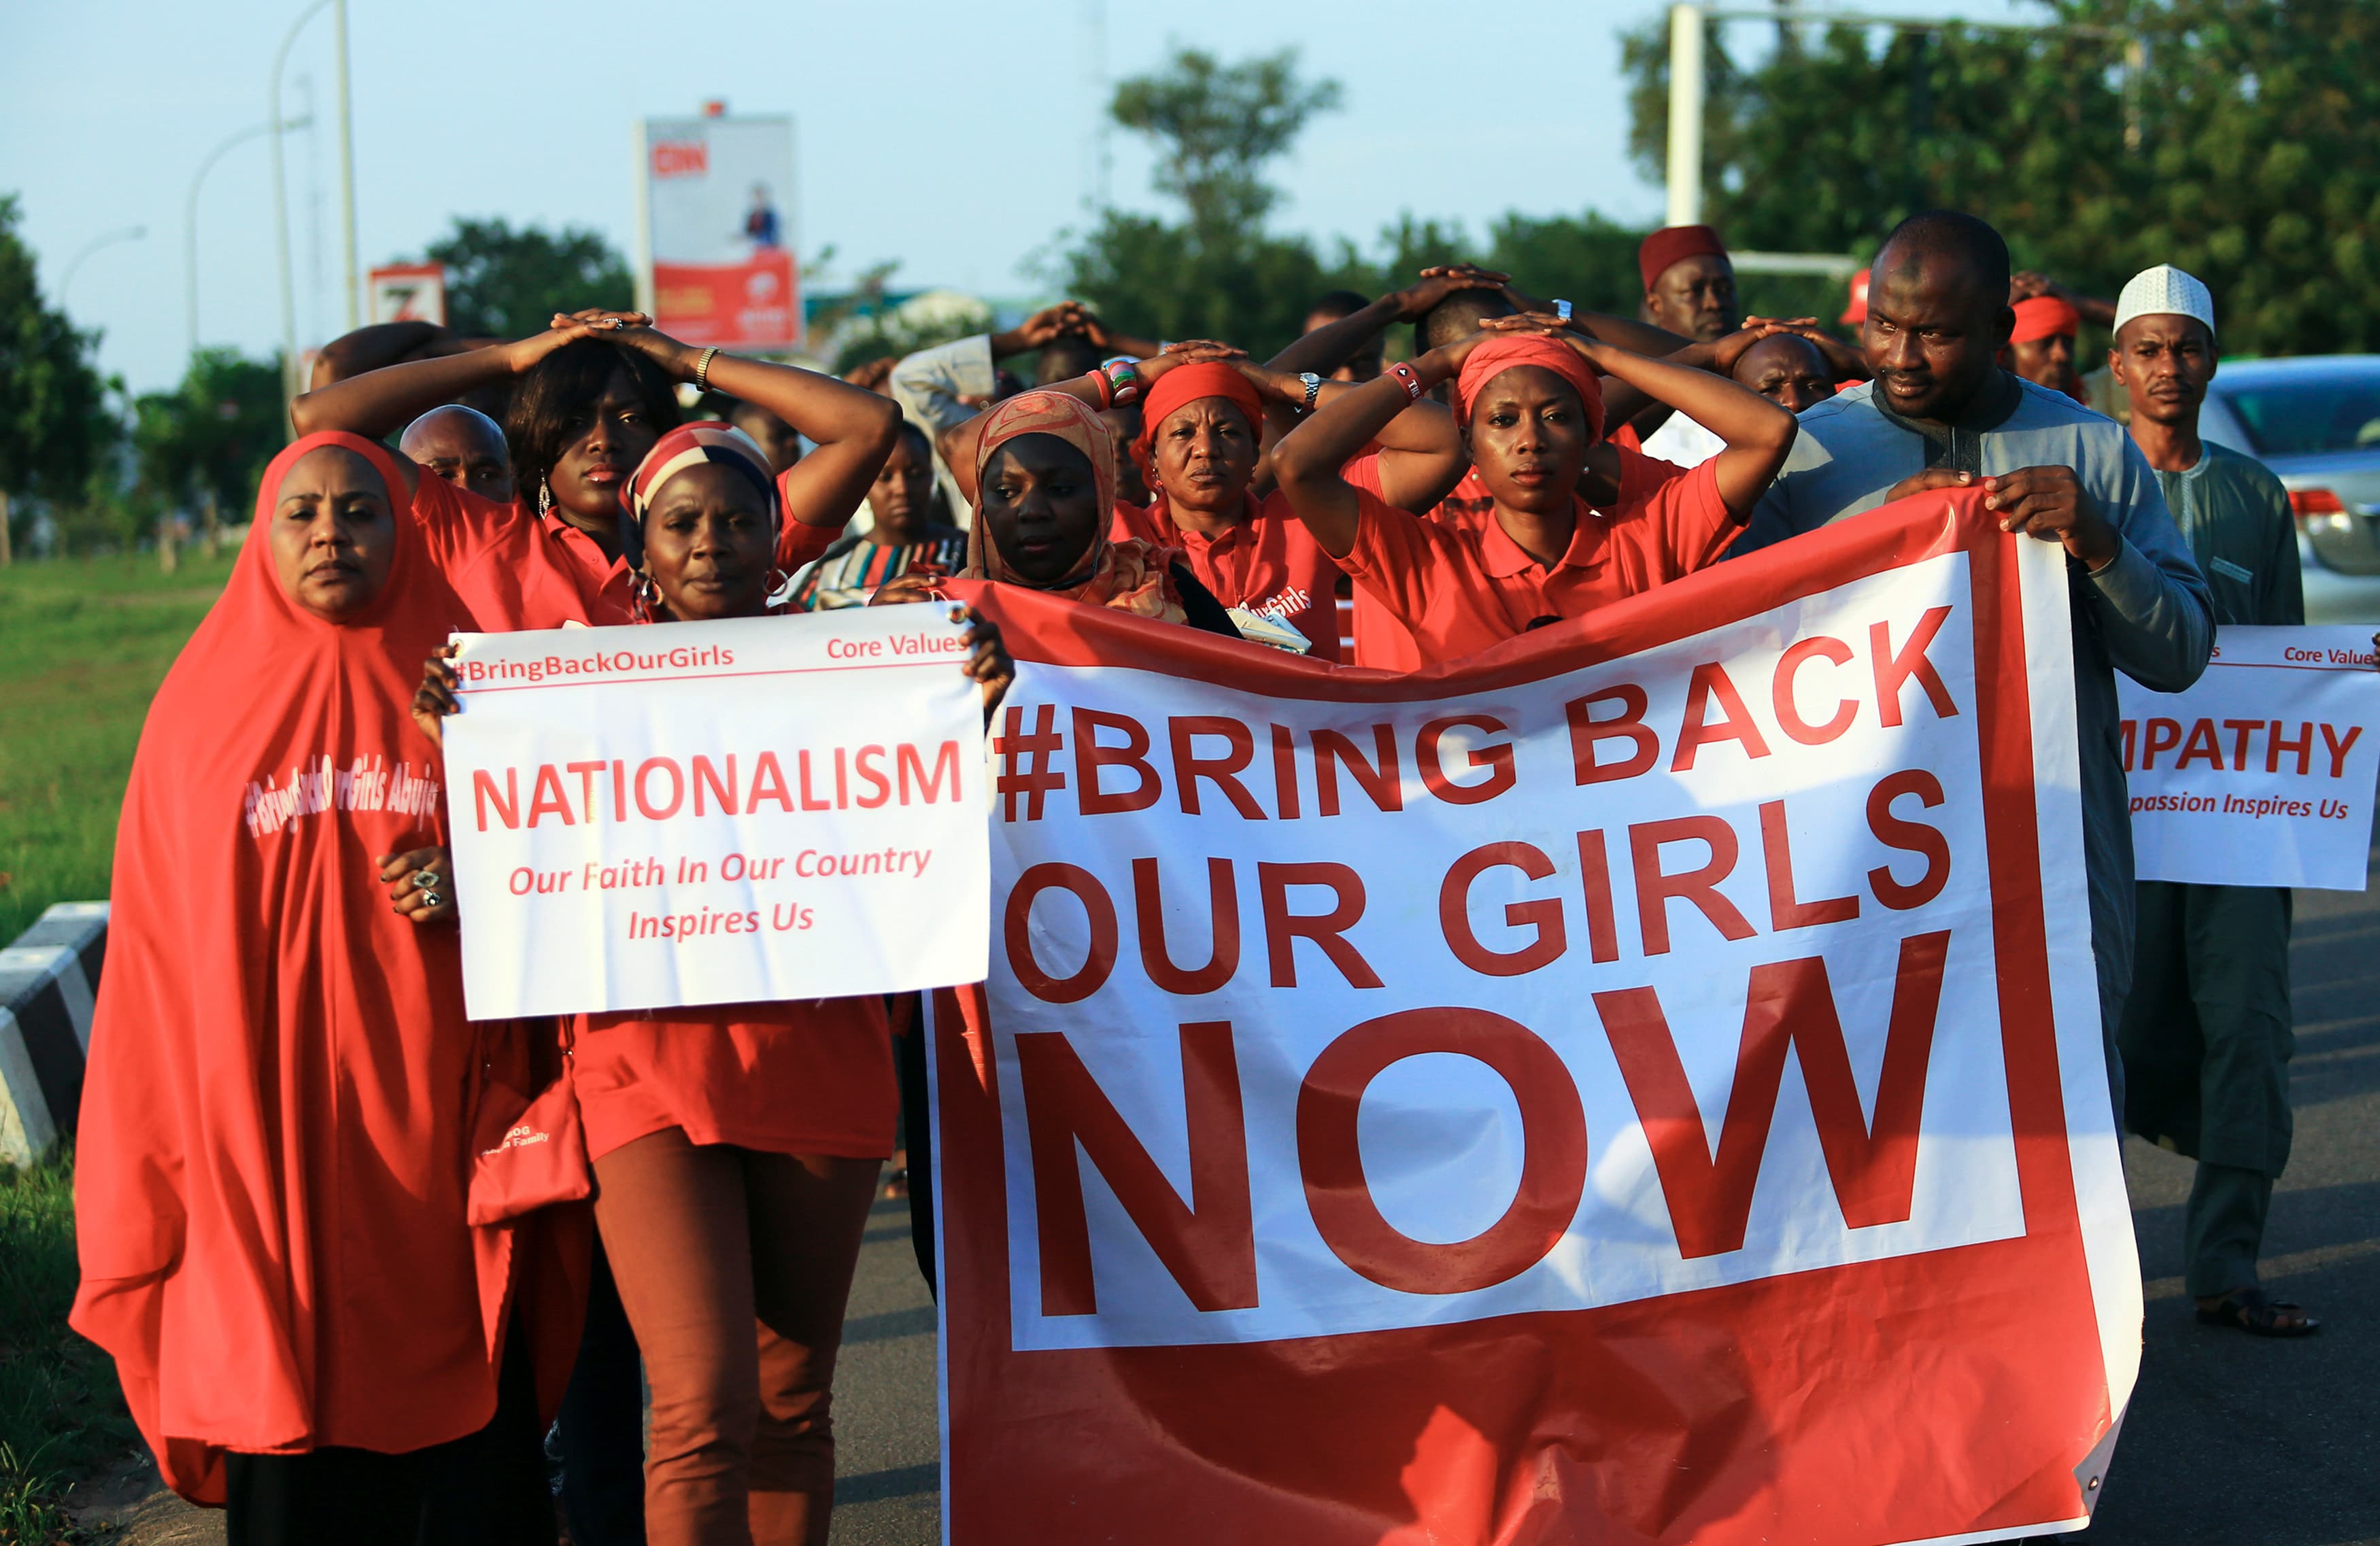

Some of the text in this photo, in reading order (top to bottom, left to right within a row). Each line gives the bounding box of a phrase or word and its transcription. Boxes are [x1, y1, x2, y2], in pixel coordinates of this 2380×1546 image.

[454, 645, 735, 682] #BringBackOurGirls
[827, 638, 882, 659] Core
[2284, 647, 2323, 663] Core
[992, 605, 1959, 822] #BRING BACK
[386, 761, 440, 833] Abuja
[472, 740, 963, 832] NATIONALISM
[2223, 793, 2312, 819] Inspires
[2319, 799, 2349, 819] Us
[509, 846, 932, 895] Our Faith In Our Country
[1005, 769, 1951, 1003] OUR GIRLS
[628, 903, 815, 943] Inspires Us
[513, 1132, 549, 1147] Family
[1014, 929, 1950, 1317] NOW
